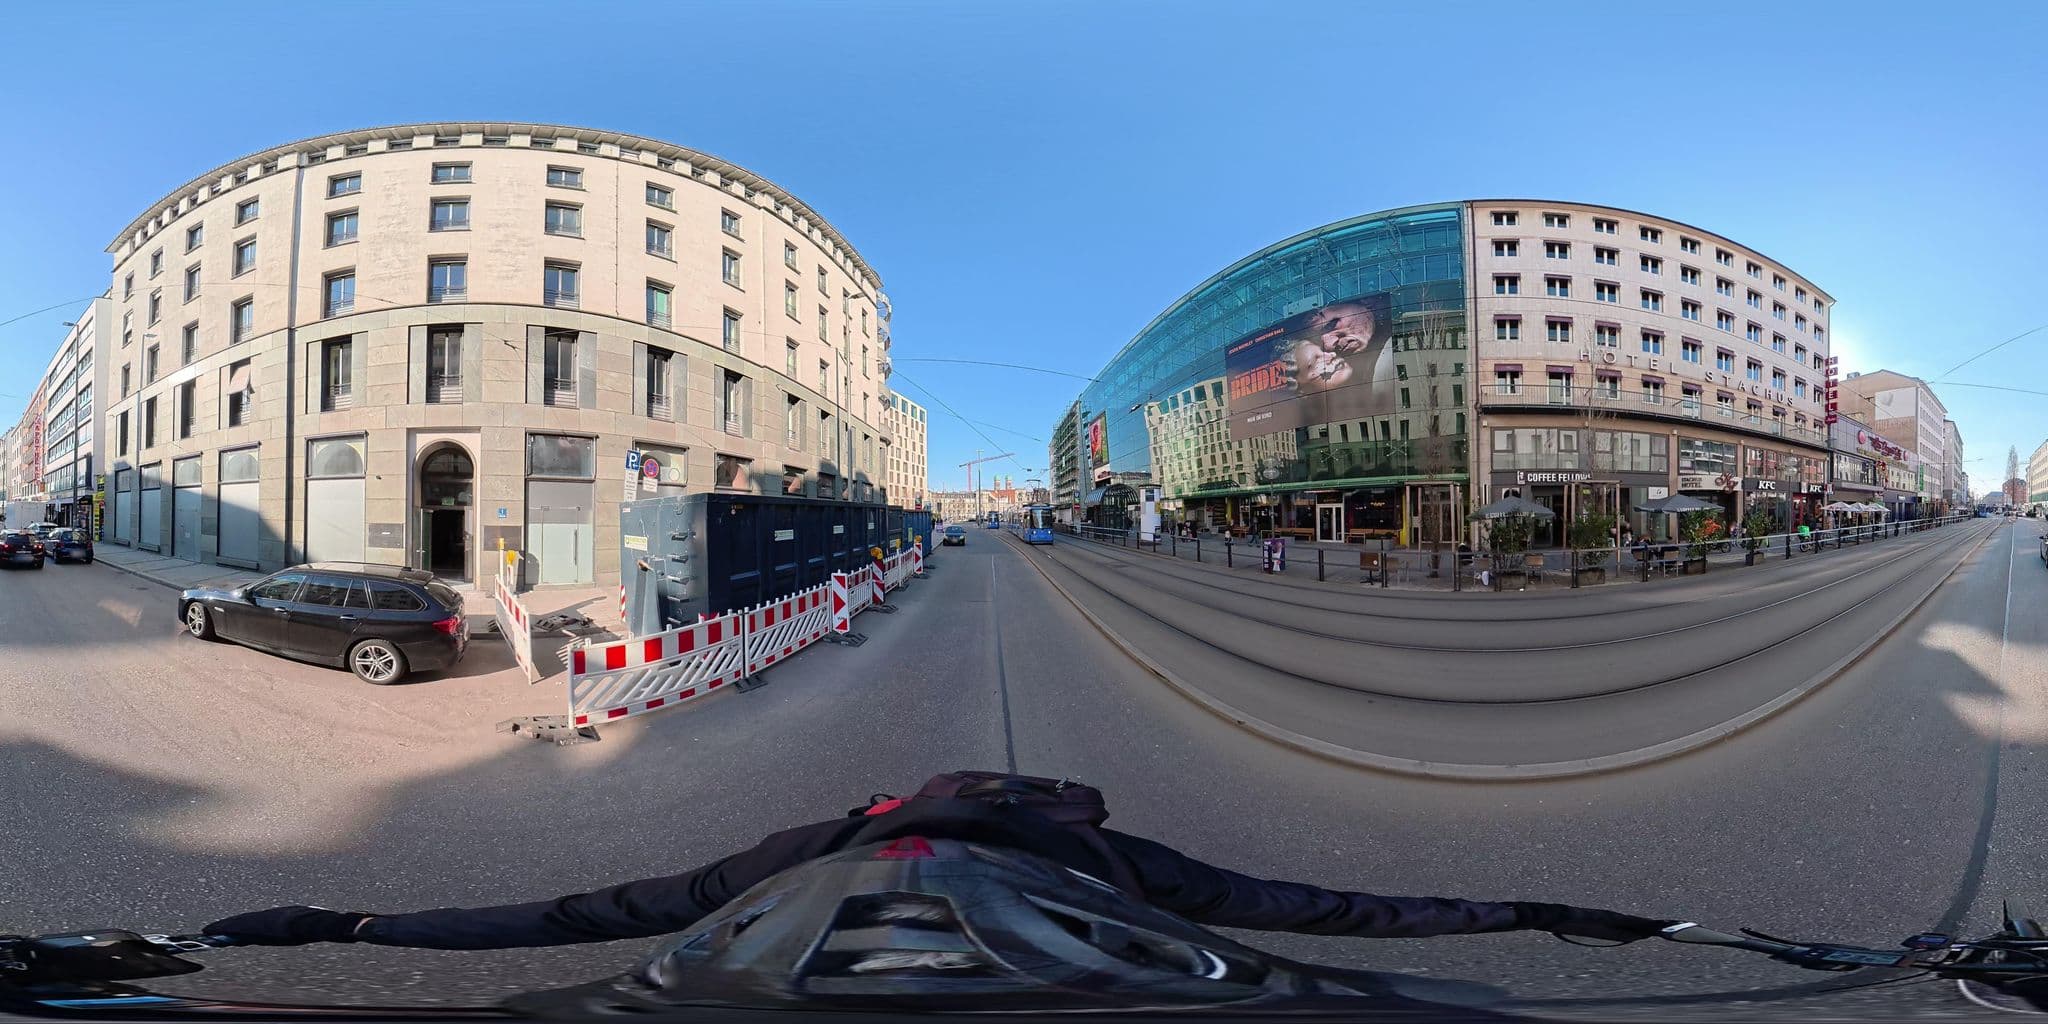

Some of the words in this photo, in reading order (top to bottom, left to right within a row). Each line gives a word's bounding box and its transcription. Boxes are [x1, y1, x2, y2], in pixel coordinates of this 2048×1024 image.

[1579, 348, 1679, 375] HOTEL
[1705, 371, 1794, 406] STACHUS
[1527, 473, 1557, 482] COFFEE
[1758, 480, 1776, 490] KFC
[1809, 484, 1822, 493] KFC
